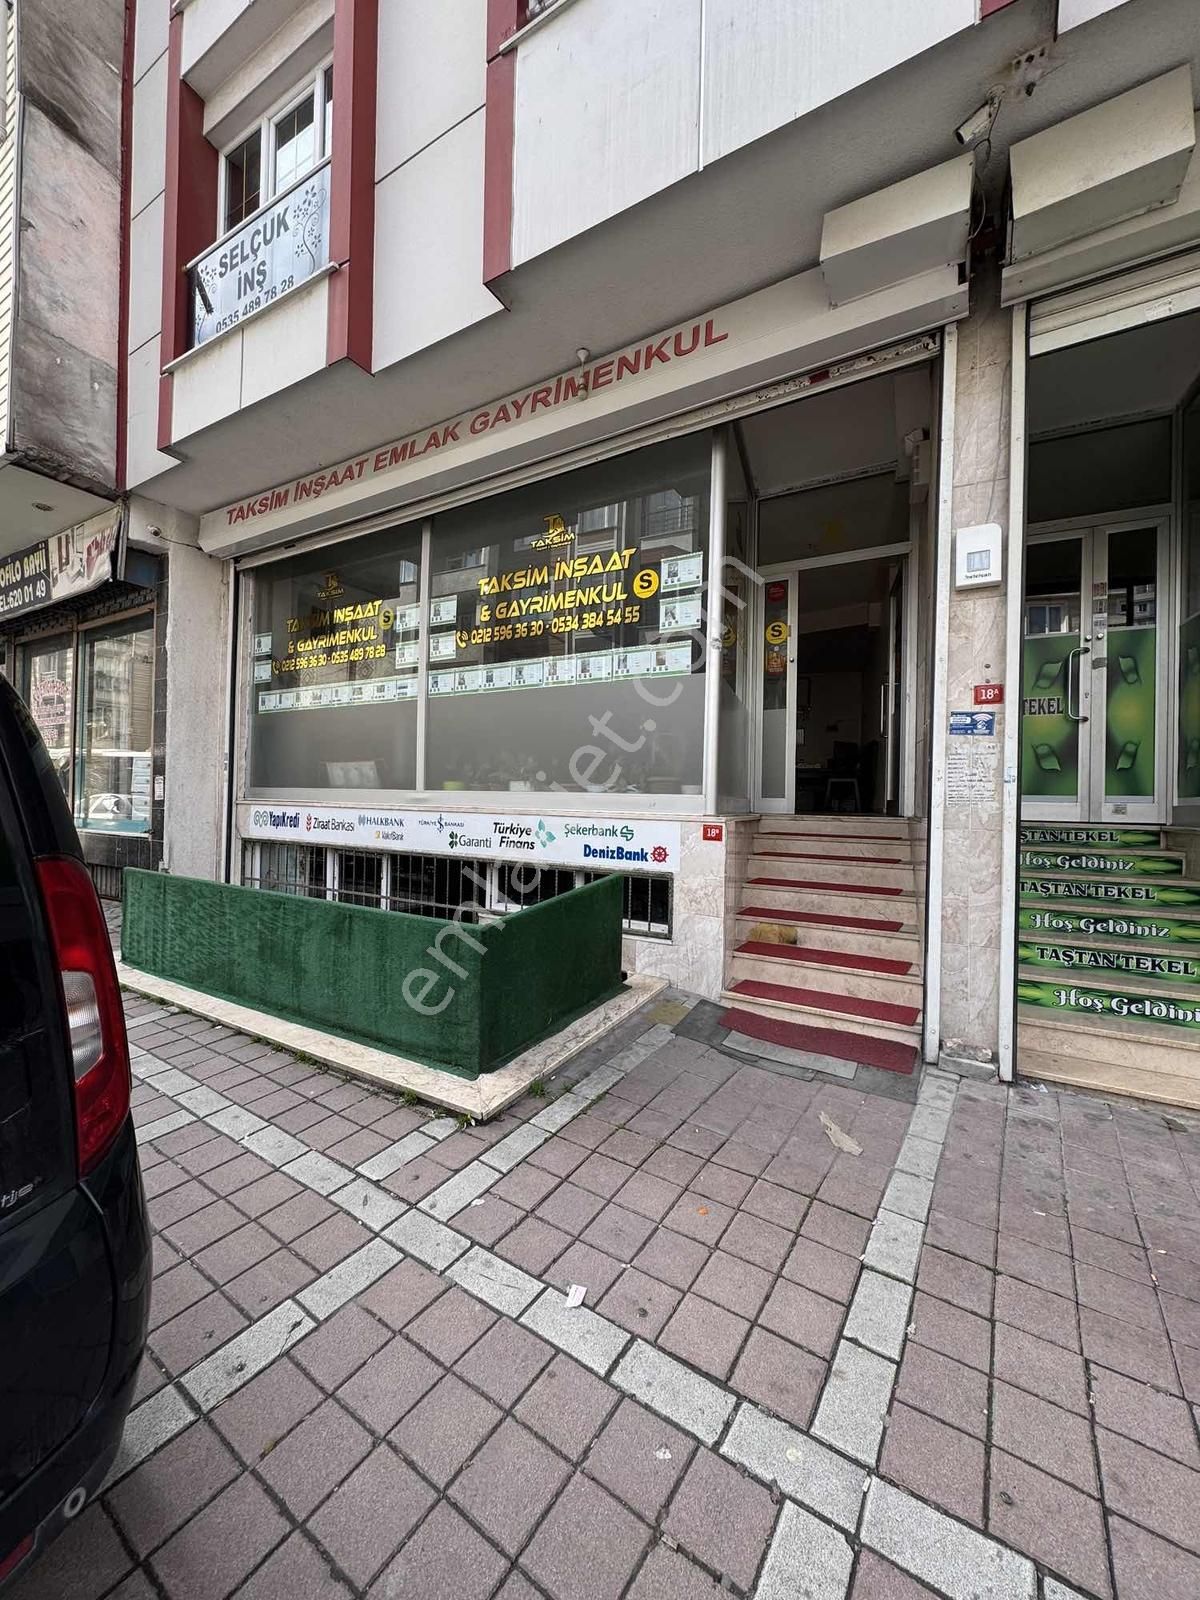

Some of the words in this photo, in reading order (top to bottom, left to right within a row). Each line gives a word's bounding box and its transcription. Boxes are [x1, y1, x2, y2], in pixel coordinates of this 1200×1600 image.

[219, 206, 290, 279] SELÇUK
[237, 260, 267, 300] İNŞ
[216, 310, 239, 333] 0535
[242, 296, 261, 315] 489
[265, 286, 277, 303] 78
[281, 275, 294, 293] 28
[227, 490, 290, 525] TAKSİM
[294, 459, 369, 502] İNŞAAT
[373, 421, 461, 472] EMLAK
[469, 319, 729, 435] GAYRİMENKUL
[477, 564, 549, 596] TAKSİM
[554, 547, 637, 584] İNŞAAT
[24, 583, 33, 603] 01
[36, 579, 46, 598] 49
[480, 605, 491, 622] &
[495, 582, 628, 619] GAYRİMENKUL
[333, 600, 382, 625] İNŞAAT
[470, 628, 492, 644] 0212
[493, 624, 512, 641] 596
[514, 622, 528, 639] 36
[530, 620, 544, 637] 30
[551, 616, 579, 634] 0534
[581, 611, 604, 630] 384
[606, 608, 621, 626] 54
[625, 605, 640, 623] 55
[297, 625, 378, 652] GAYRİMENKUL
[295, 656, 307, 670] 596
[308, 655, 318, 668] 36
[317, 653, 327, 666] 30
[331, 650, 349, 664] 0535
[349, 648, 364, 661] 489
[365, 646, 375, 659] 78
[375, 644, 386, 658] 28
[1023, 697, 1064, 716] TEKEL
[313, 816, 331, 830] Ziraat
[331, 818, 355, 832] Bankası
[366, 816, 405, 827] HALKBANK
[493, 821, 532, 838] Türkiye
[564, 823, 618, 838] Şekerbank
[459, 835, 492, 849] Garanti
[499, 836, 535, 851] Finans
[1063, 830, 1121, 843] TEKEL
[583, 844, 649, 863] DenizBank
[1056, 855, 1136, 871] Geldiniz
[1019, 881, 1089, 897] TAŞTAN
[1092, 885, 1158, 901] TEKEL
[1030, 912, 1073, 933] Hoş
[1079, 917, 1171, 938] Geldiniz
[1036, 946, 1118, 969] TAŞTAN
[1120, 954, 1198, 978] TEKEL
[1052, 988, 1105, 1013] Hoş
